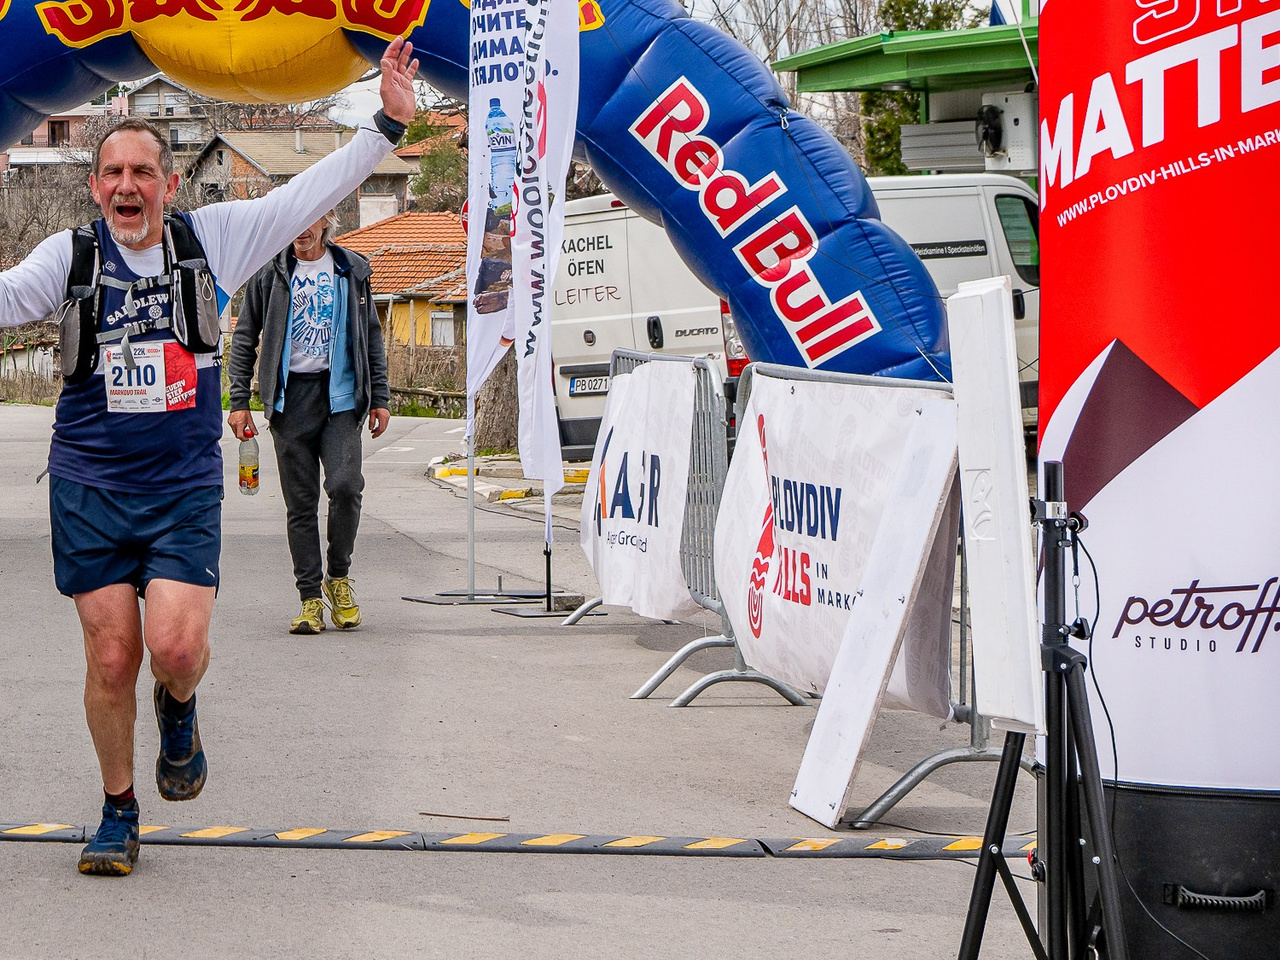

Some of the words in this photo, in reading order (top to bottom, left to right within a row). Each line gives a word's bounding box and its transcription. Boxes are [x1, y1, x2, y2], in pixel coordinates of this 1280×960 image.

[634, 81, 781, 232] Red
[738, 211, 875, 362] Bull
[568, 258, 605, 277] ÖFEN
[554, 285, 622, 306] LEITER
[675, 327, 719, 338] DUCATO
[111, 364, 156, 387] 2110
[771, 475, 842, 541] PLOVDIV
[816, 562, 828, 579] IN
[1134, 635, 1217, 653] STUDIO
